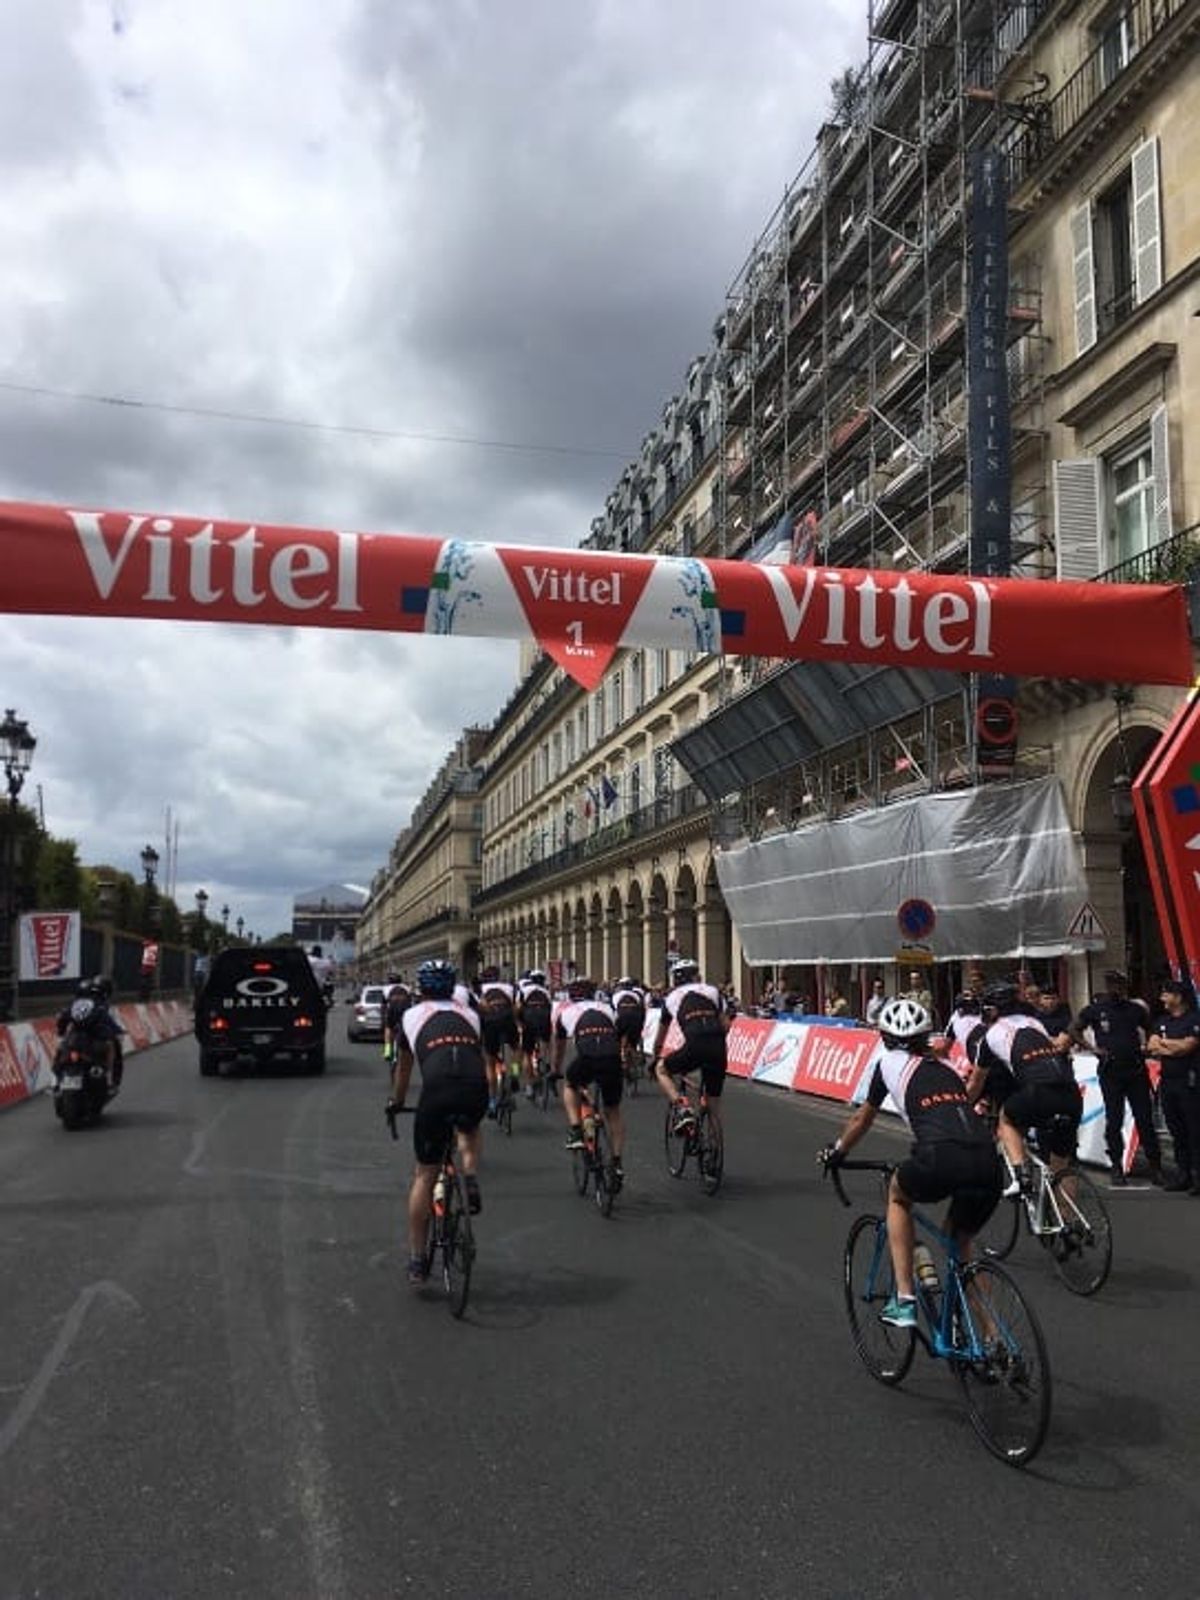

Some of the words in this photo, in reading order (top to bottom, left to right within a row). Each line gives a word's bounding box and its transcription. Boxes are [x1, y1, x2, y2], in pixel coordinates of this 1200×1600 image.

[67, 510, 364, 612] Vittel
[522, 565, 621, 605] Vittel
[566, 620, 583, 647] 1
[755, 563, 994, 657] Vittel
[40, 919, 61, 975] Vittel
[223, 996, 300, 1009] OAKLEY
[806, 1037, 868, 1086] Vittel
